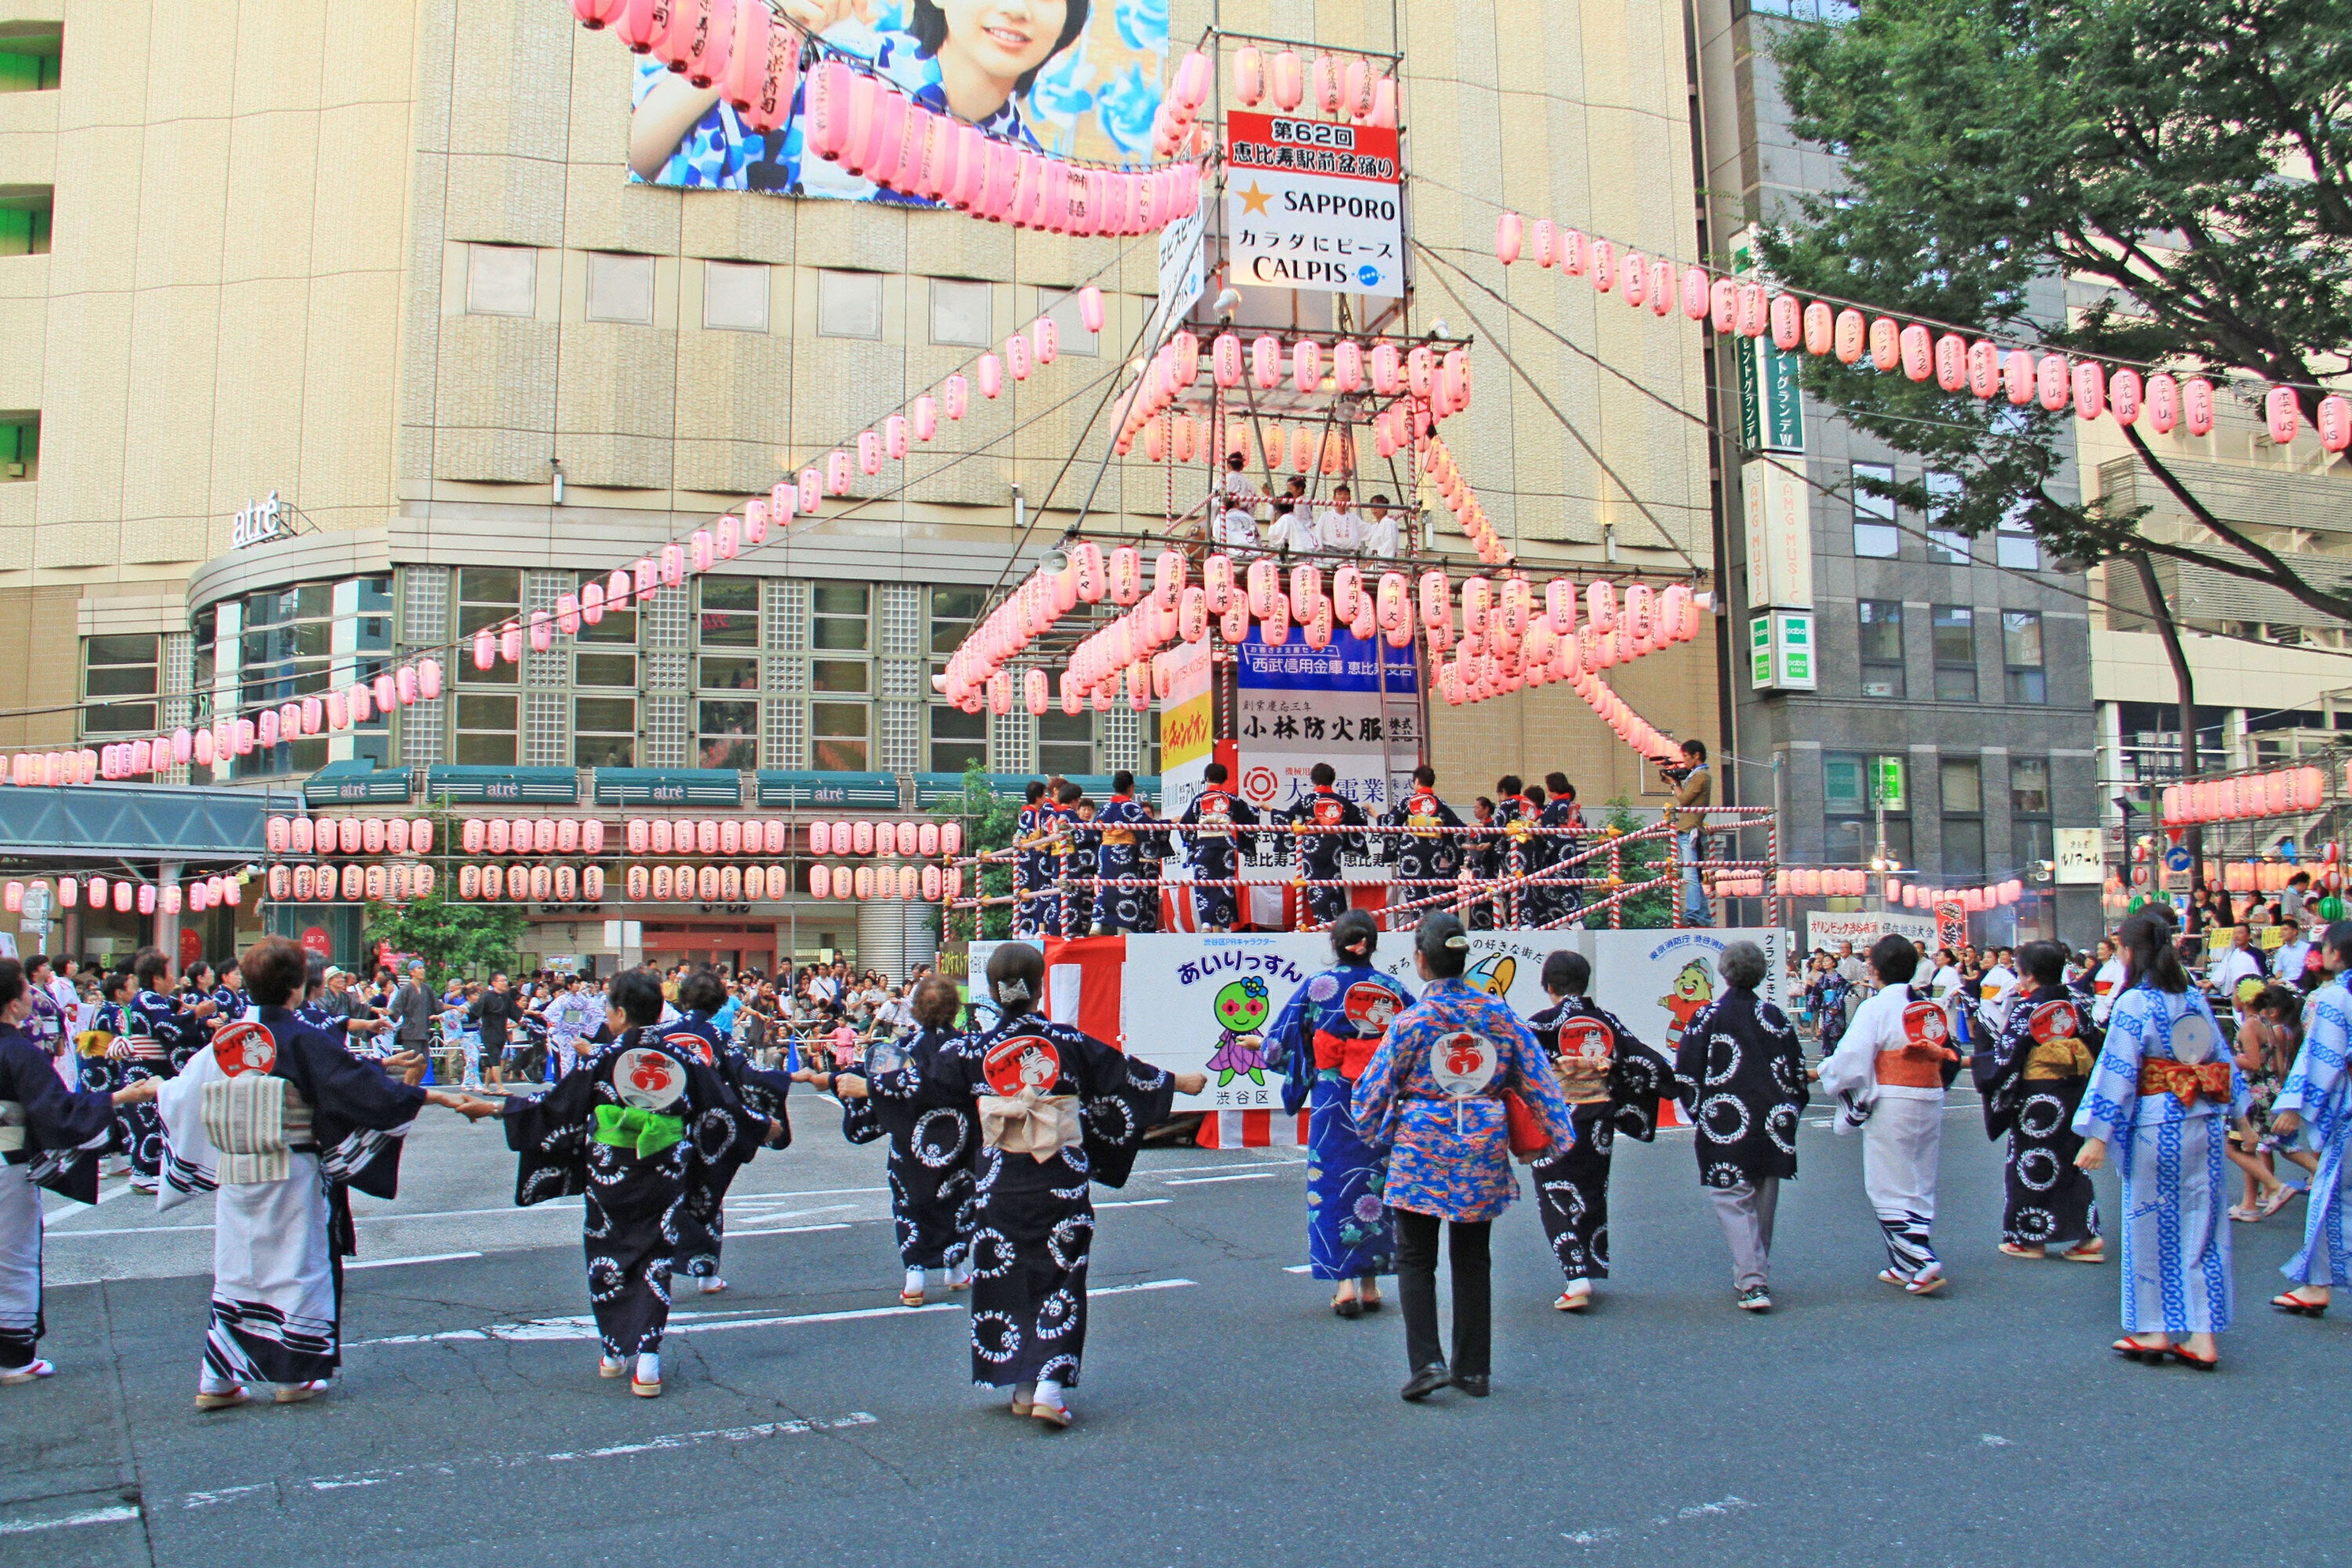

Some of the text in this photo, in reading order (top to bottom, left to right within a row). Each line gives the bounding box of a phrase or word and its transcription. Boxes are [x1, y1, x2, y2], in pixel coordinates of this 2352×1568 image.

[1272, 119, 1355, 147] 第62回
[1232, 141, 1394, 178] 恵比寿駅前盆踊り
[1284, 191, 1396, 221] SAPPORO
[1239, 229, 1394, 260] カラダにピース
[1252, 256, 1348, 283] CALPIS
[234, 490, 281, 545] atré
[1750, 486, 1762, 606] AMG MUSIC
[1783, 484, 1799, 604] AMG MUSIC
[1348, 575, 1358, 615] 寿司文
[1171, 654, 1210, 684] MITSUKOSHI
[1253, 658, 1343, 675] 西武信用金庫
[1243, 714, 1385, 742] 小林防火服
[1388, 717, 1414, 731] 株式
[339, 782, 367, 798] atré
[487, 781, 519, 797] atré
[652, 783, 685, 800] atré
[814, 786, 844, 802] atré
[1283, 777, 1385, 804] 大電業
[2060, 852, 2101, 866] ルノアール
[1472, 938, 1544, 965] の好きな街だ
[1648, 935, 1691, 960] 東京消防庁
[1177, 949, 1305, 986] あいりっすん
[1216, 1090, 1269, 1105] 渋谷区
